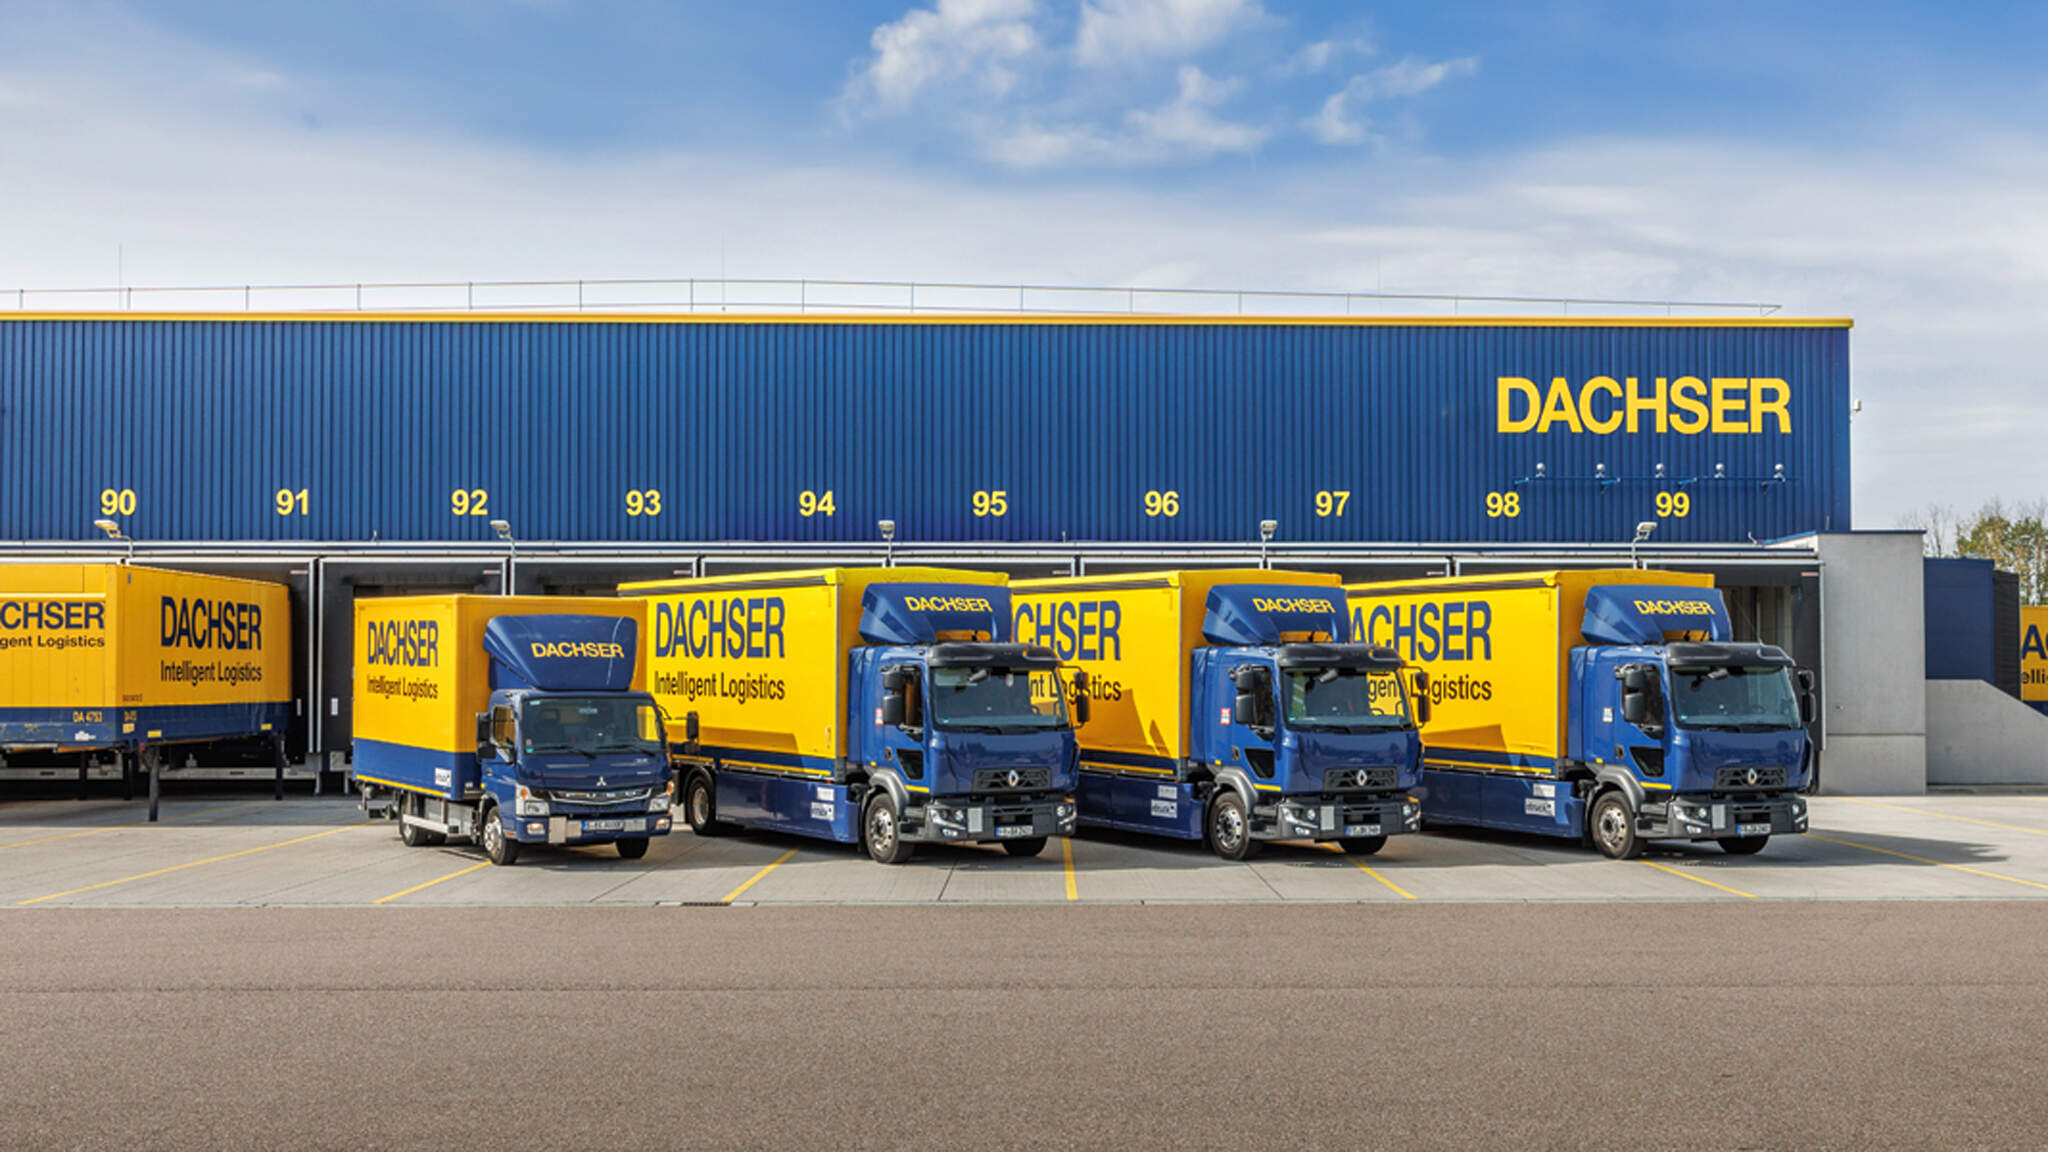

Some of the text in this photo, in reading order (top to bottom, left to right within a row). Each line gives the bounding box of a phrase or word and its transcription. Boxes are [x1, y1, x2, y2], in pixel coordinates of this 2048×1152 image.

[1497, 375, 1792, 435] DACHSER
[100, 489, 136, 516] 90
[276, 489, 309, 515] 91
[452, 489, 488, 516] 92
[626, 490, 661, 516] 93
[799, 491, 835, 516] 94
[973, 491, 1007, 516] 95
[1145, 491, 1179, 516] 96
[1316, 491, 1350, 516] 97
[1486, 492, 1520, 517] 98
[1656, 492, 1690, 517] 99
[904, 596, 993, 613] DACHSER
[1252, 598, 1337, 614] DACHSER
[1633, 600, 1717, 616] DACHSER
[161, 596, 262, 651] DACHSER
[655, 597, 785, 659] DACHSER
[37, 635, 105, 650] Logistics
[367, 619, 438, 668] DACHSER
[530, 642, 625, 659] DACHSER
[161, 660, 262, 686] Intelligent Logistics
[366, 674, 438, 702] Intelligent Logistics
[654, 670, 786, 704] Intelligent Logistics
